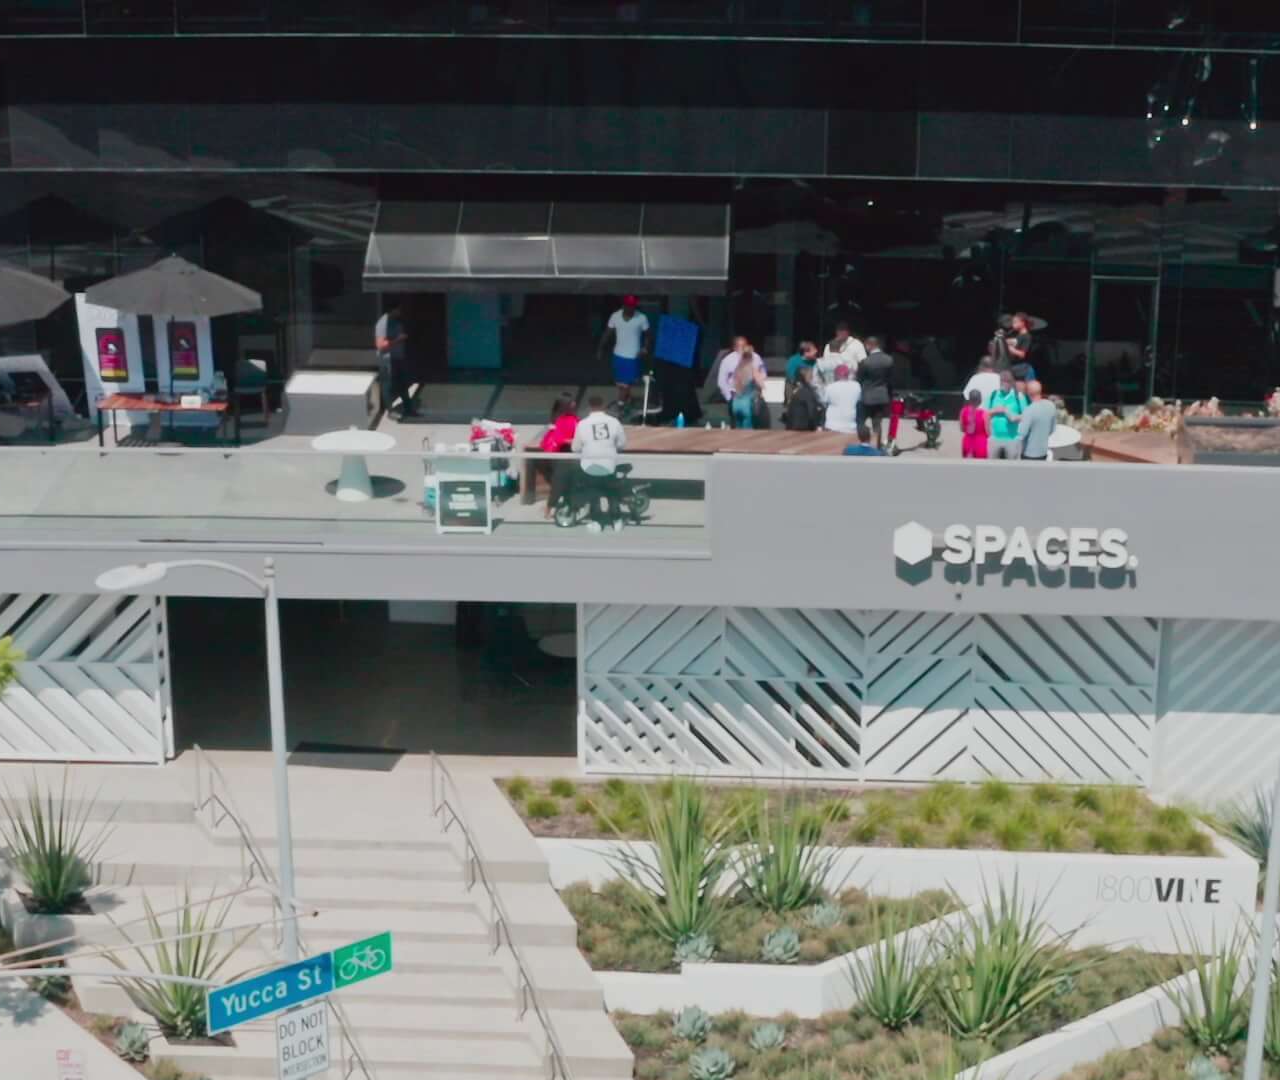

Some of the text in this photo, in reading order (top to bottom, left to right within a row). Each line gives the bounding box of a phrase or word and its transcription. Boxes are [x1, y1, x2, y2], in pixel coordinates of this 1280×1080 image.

[941, 524, 1139, 569] SPACES.
[221, 965, 323, 1017] Yucca St
[280, 1010, 324, 1040] DO NOT
[283, 1034, 325, 1062] BLOCK
